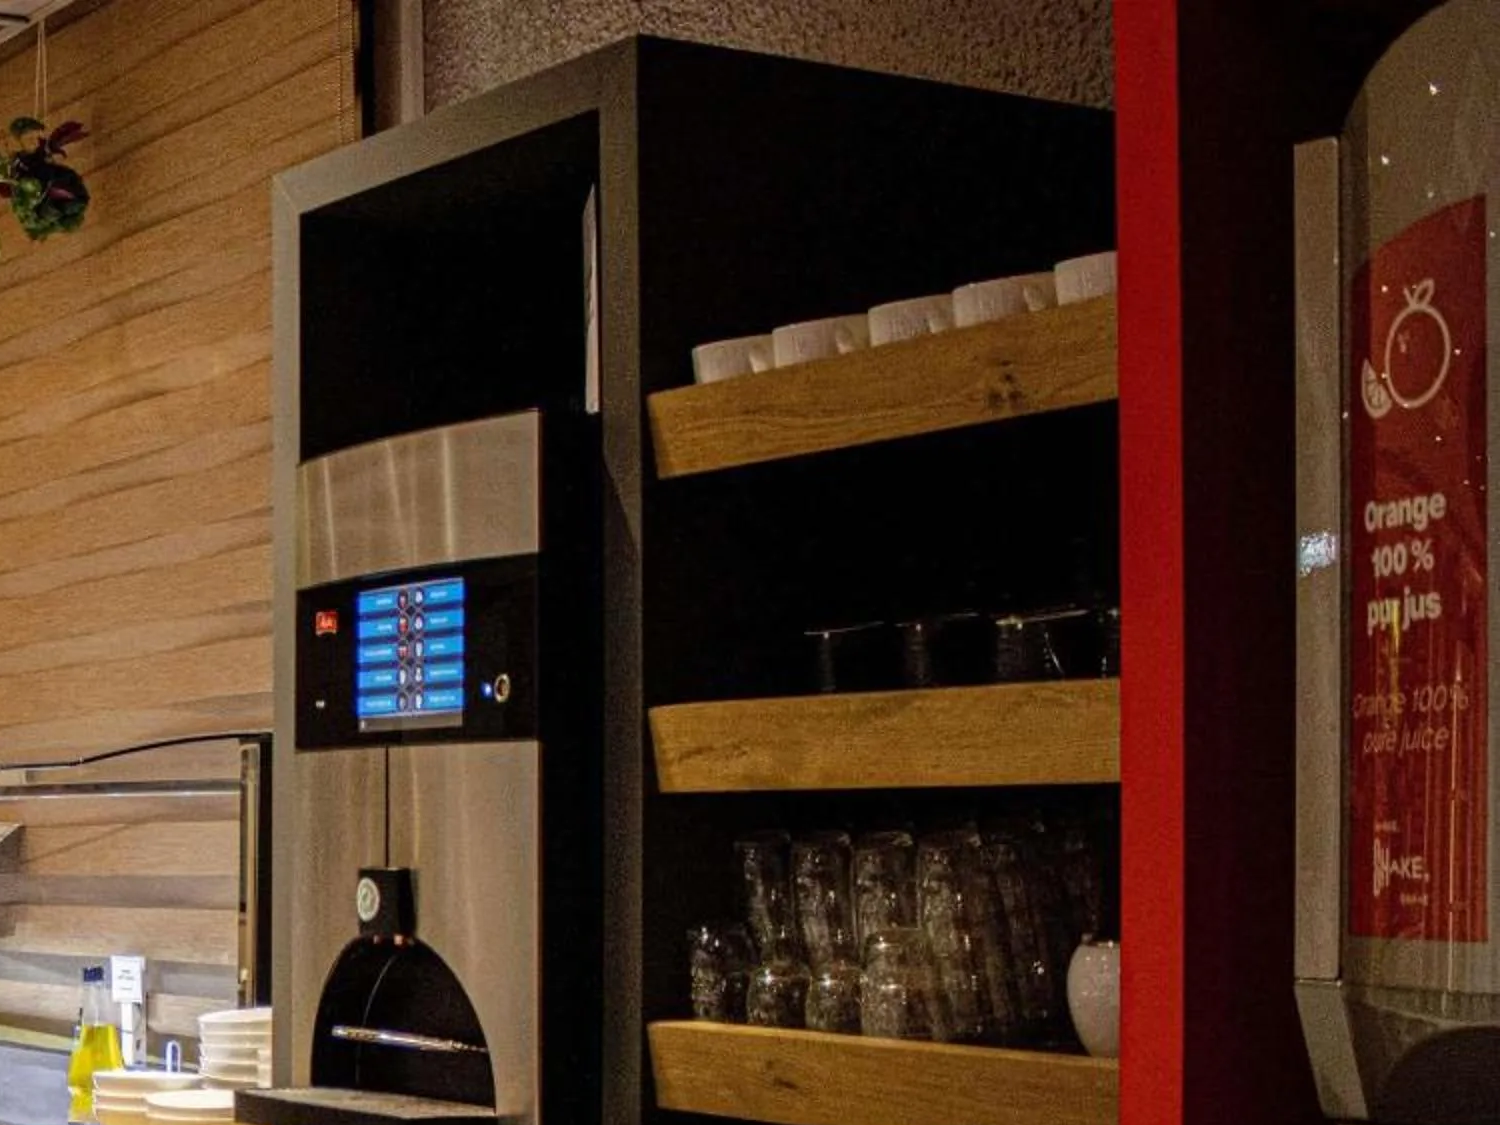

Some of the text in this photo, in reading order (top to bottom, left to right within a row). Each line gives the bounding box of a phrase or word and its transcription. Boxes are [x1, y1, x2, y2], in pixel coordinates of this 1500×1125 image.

[1364, 492, 1447, 533] Orange
[1371, 543, 1407, 579] 100
[1402, 585, 1442, 632] jus
